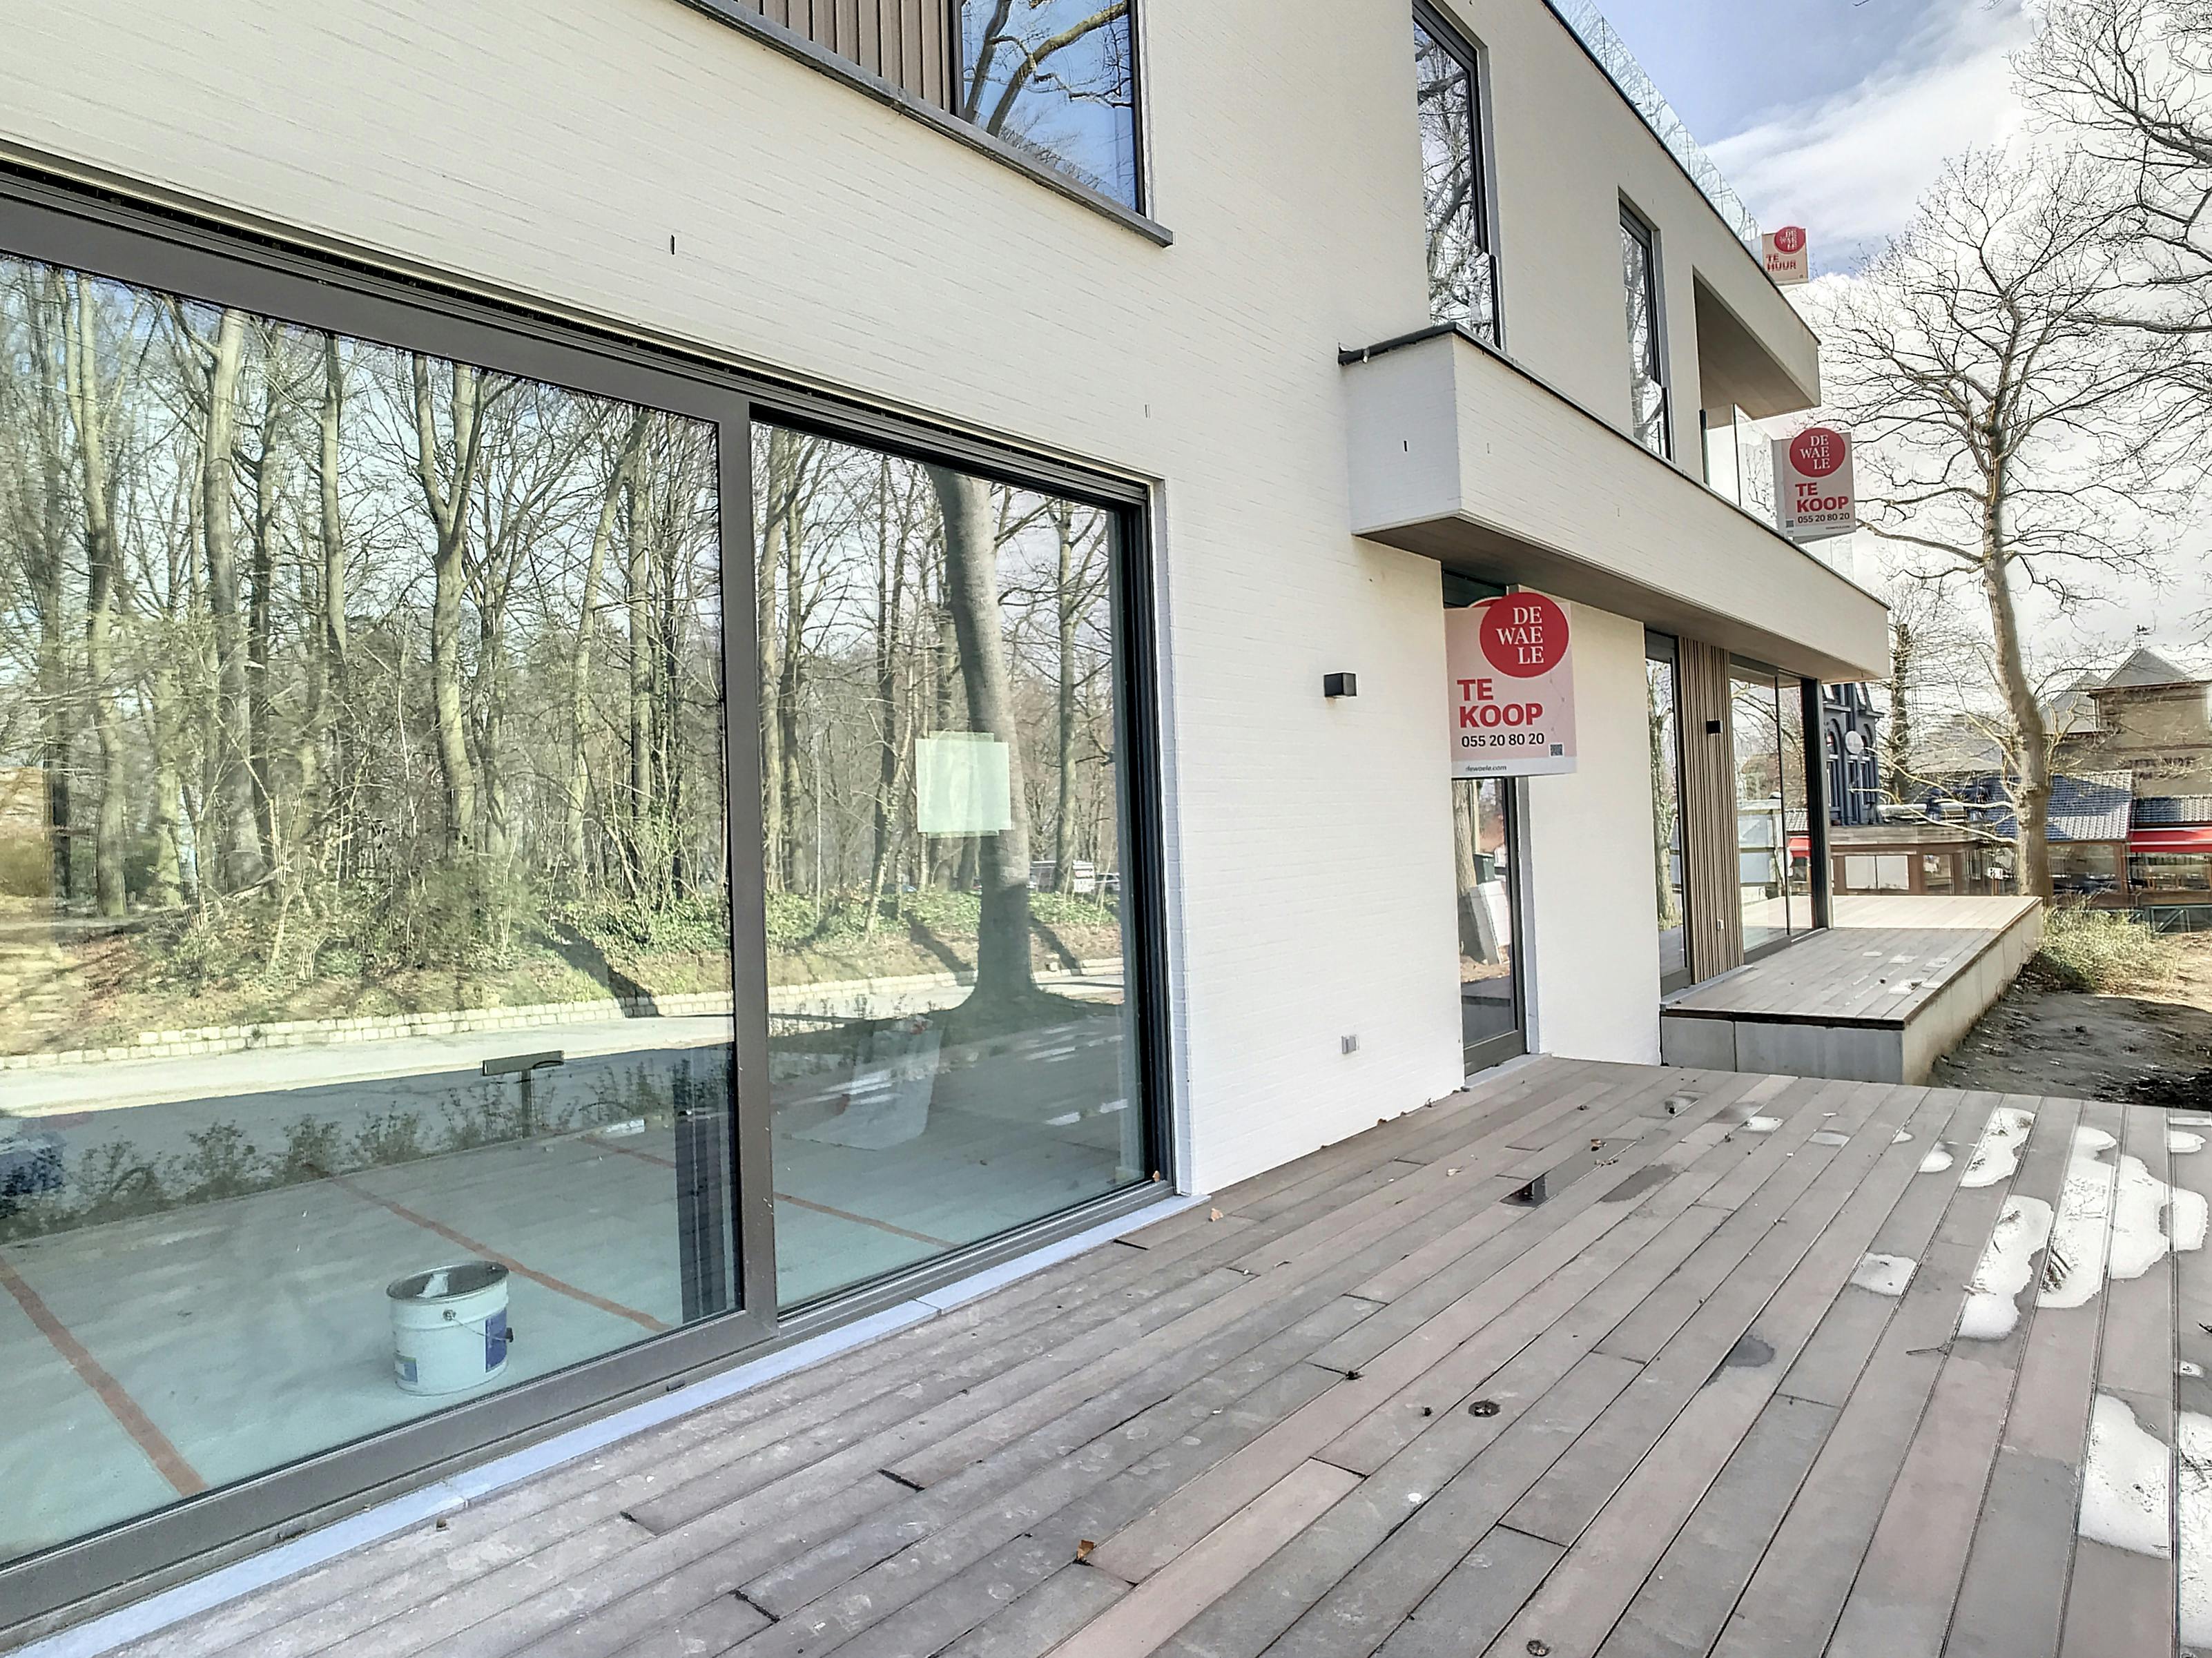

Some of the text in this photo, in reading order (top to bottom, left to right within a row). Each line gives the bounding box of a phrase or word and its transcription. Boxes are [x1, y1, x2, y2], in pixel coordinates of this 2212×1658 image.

[1766, 253, 1778, 262] TE
[1767, 260, 1796, 271] HUUR
[1810, 434, 1830, 447] DE
[1800, 447, 1830, 459] WAE
[1813, 458, 1831, 470] LE
[1795, 482, 1818, 497] TE
[1796, 496, 1850, 514] KOOP
[1797, 512, 1850, 524] 055 20 80 20
[1513, 606, 1543, 625] DE
[1495, 625, 1544, 645] WAE
[1517, 645, 1545, 665] LE
[1457, 678, 1494, 702] TE
[1459, 703, 1544, 729] KOOP
[1461, 732, 1545, 748] 055 20 80 20
